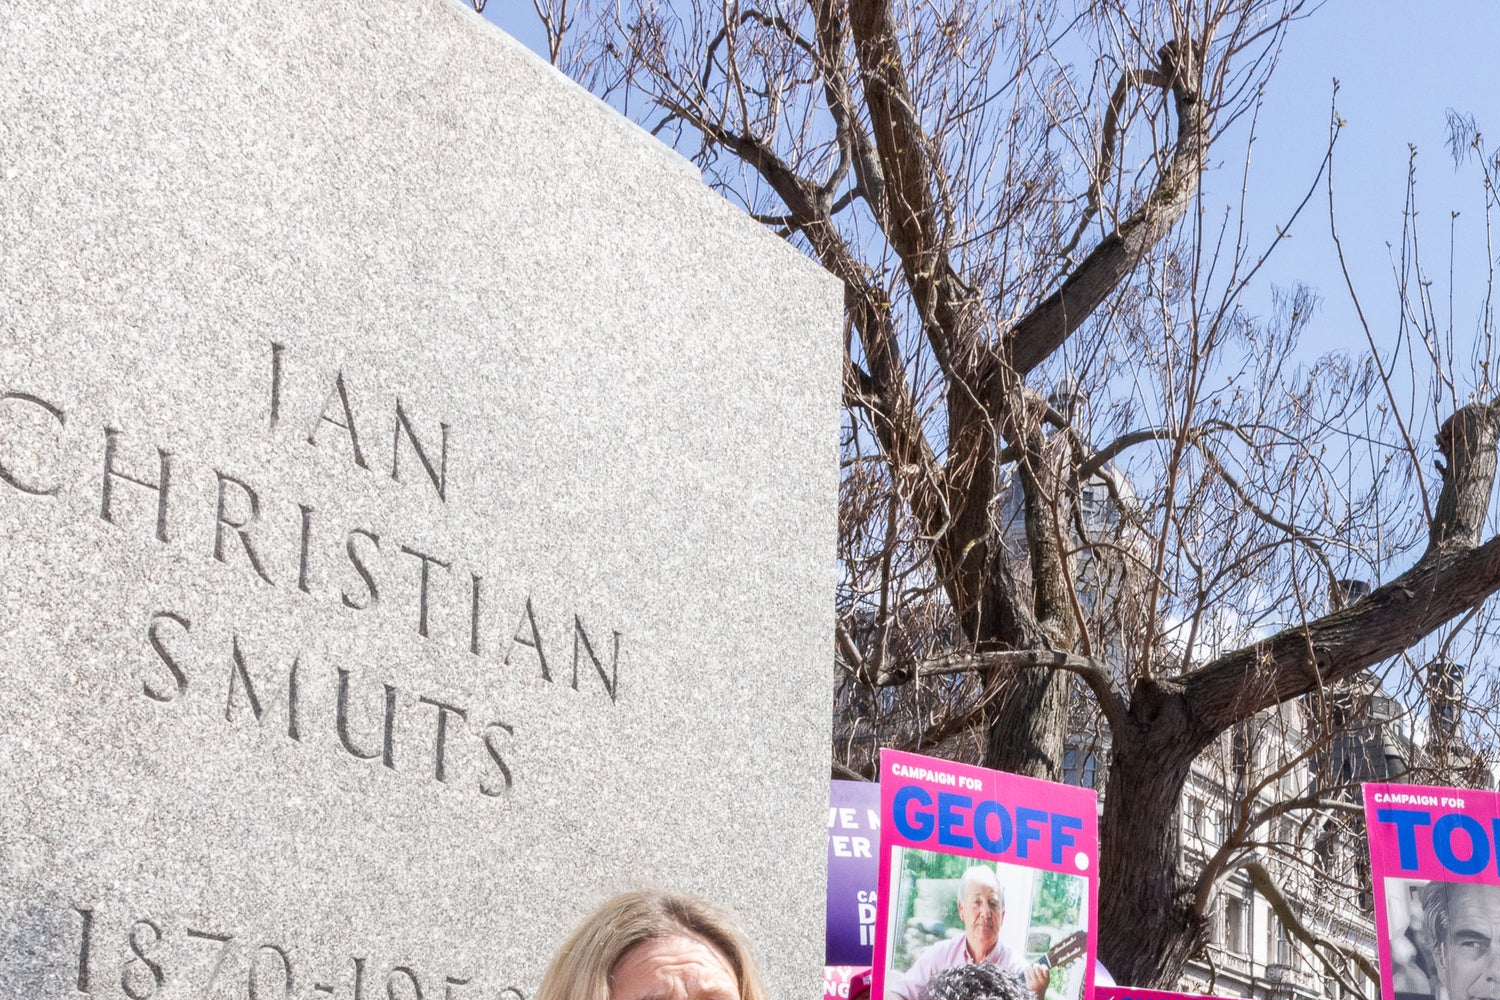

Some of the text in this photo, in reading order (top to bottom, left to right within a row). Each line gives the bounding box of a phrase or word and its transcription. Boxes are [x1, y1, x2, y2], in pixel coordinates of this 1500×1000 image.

[270, 341, 449, 502] IAN
[0, 391, 621, 706] CHRISTIAN
[142, 610, 515, 798] SMUTS
[891, 763, 982, 791] CAMPAIGN FOR
[892, 785, 1089, 871] GEOFF.
[1374, 793, 1465, 809] CAMPAIGN FOR
